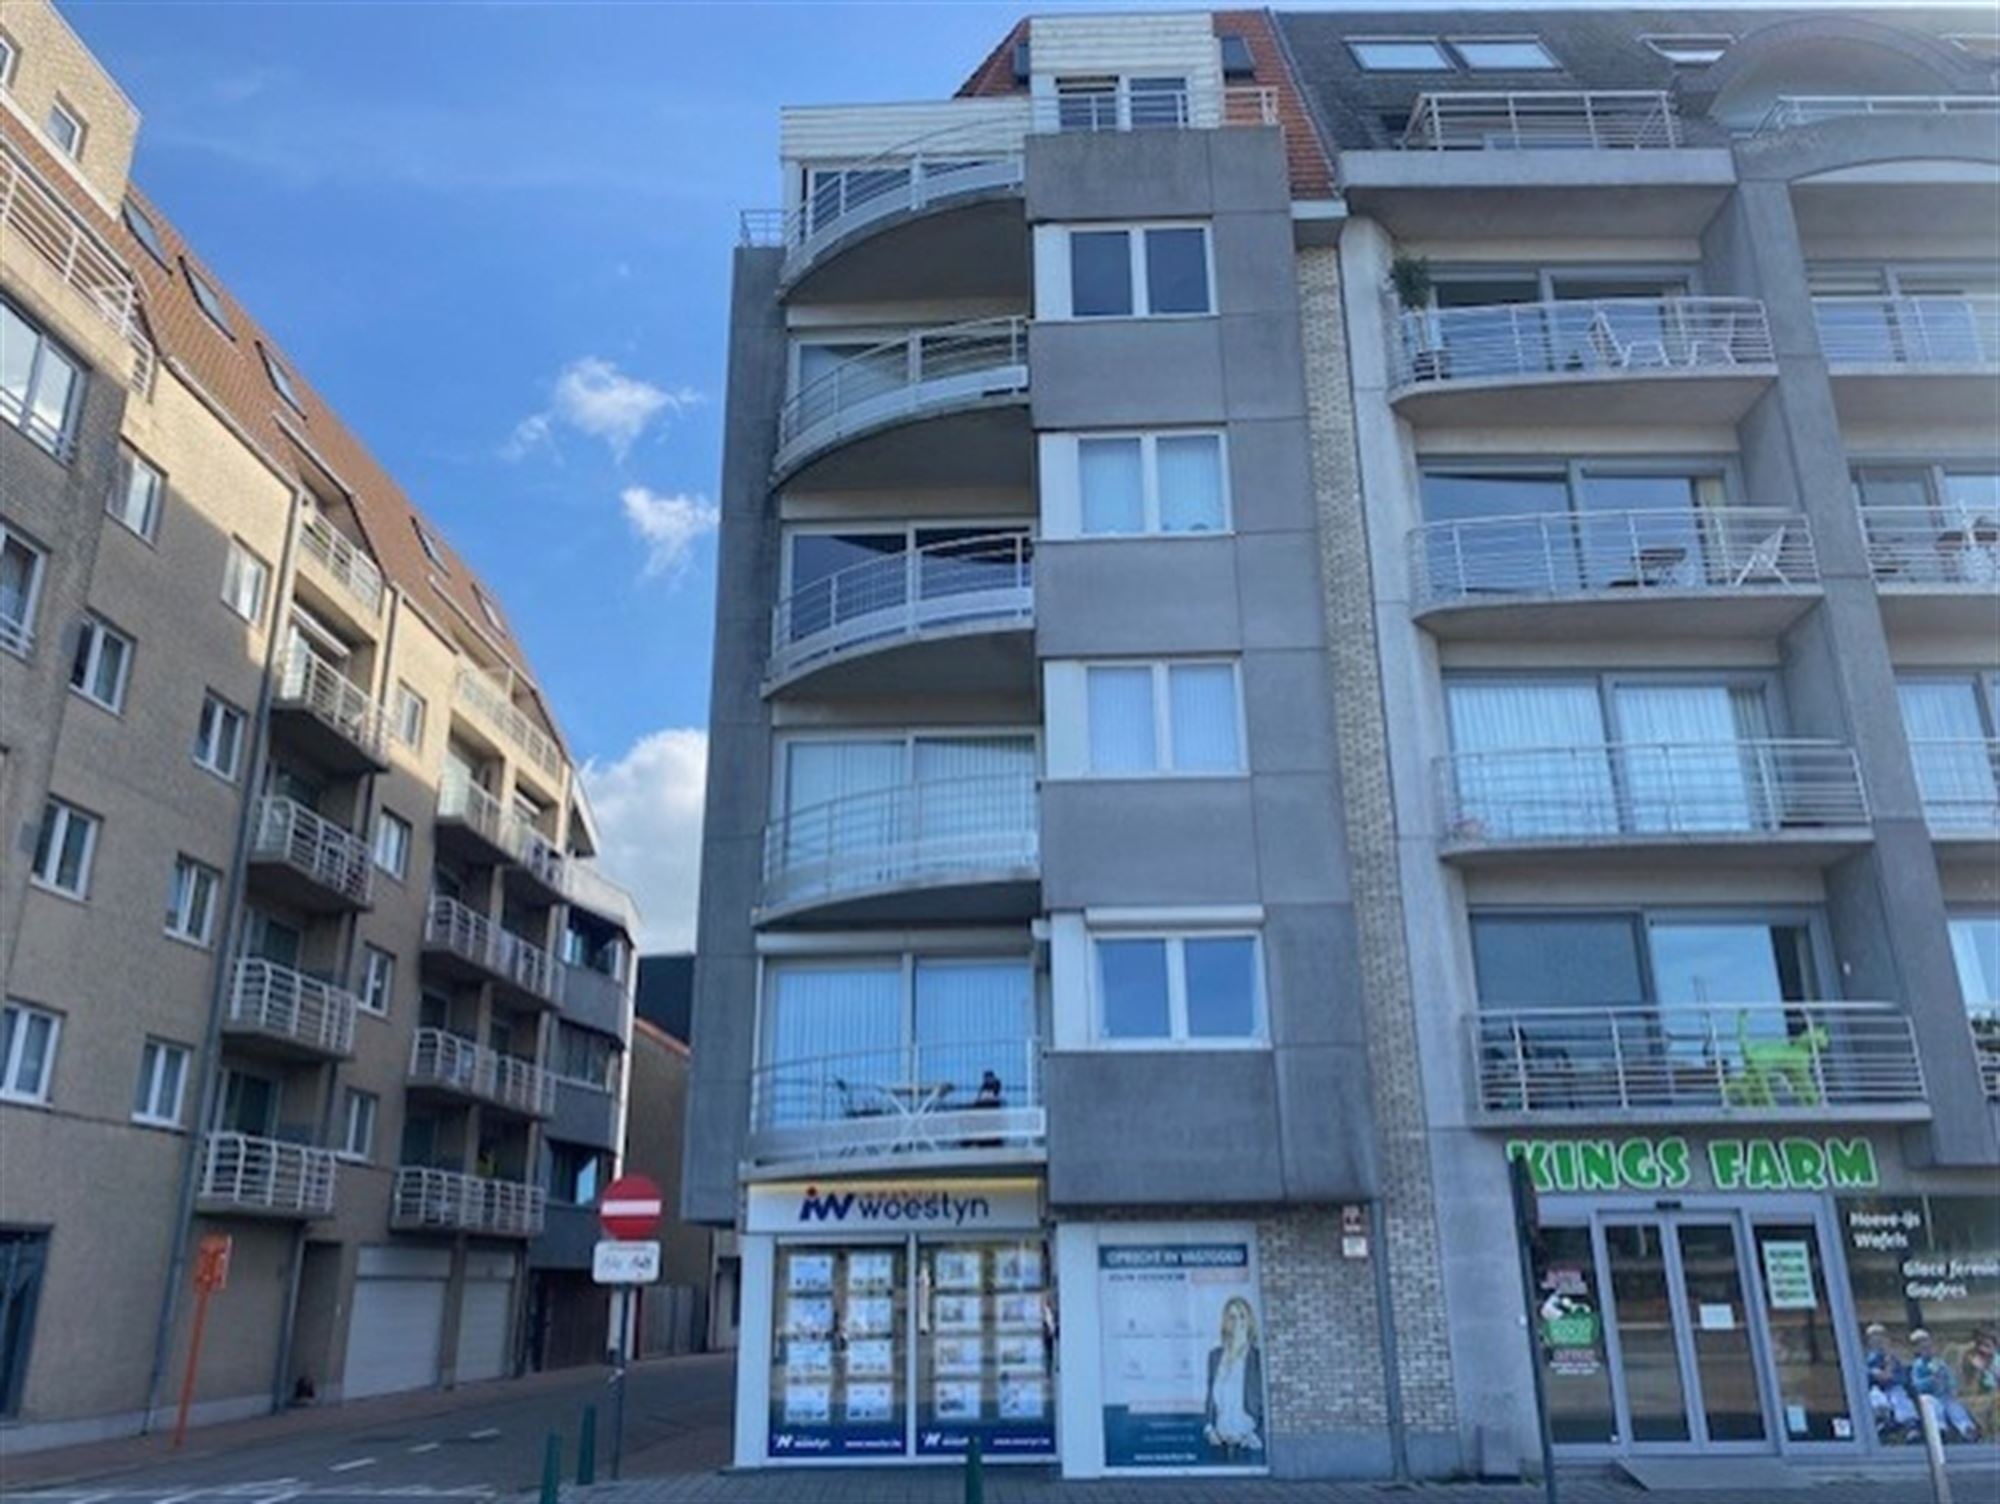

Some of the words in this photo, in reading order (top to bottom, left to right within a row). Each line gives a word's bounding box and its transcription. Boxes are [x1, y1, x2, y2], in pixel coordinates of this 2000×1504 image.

[1506, 1138, 1691, 1191] KINGS
[1708, 1138, 1879, 1190] FARM
[858, 1192, 990, 1225] woestyn
